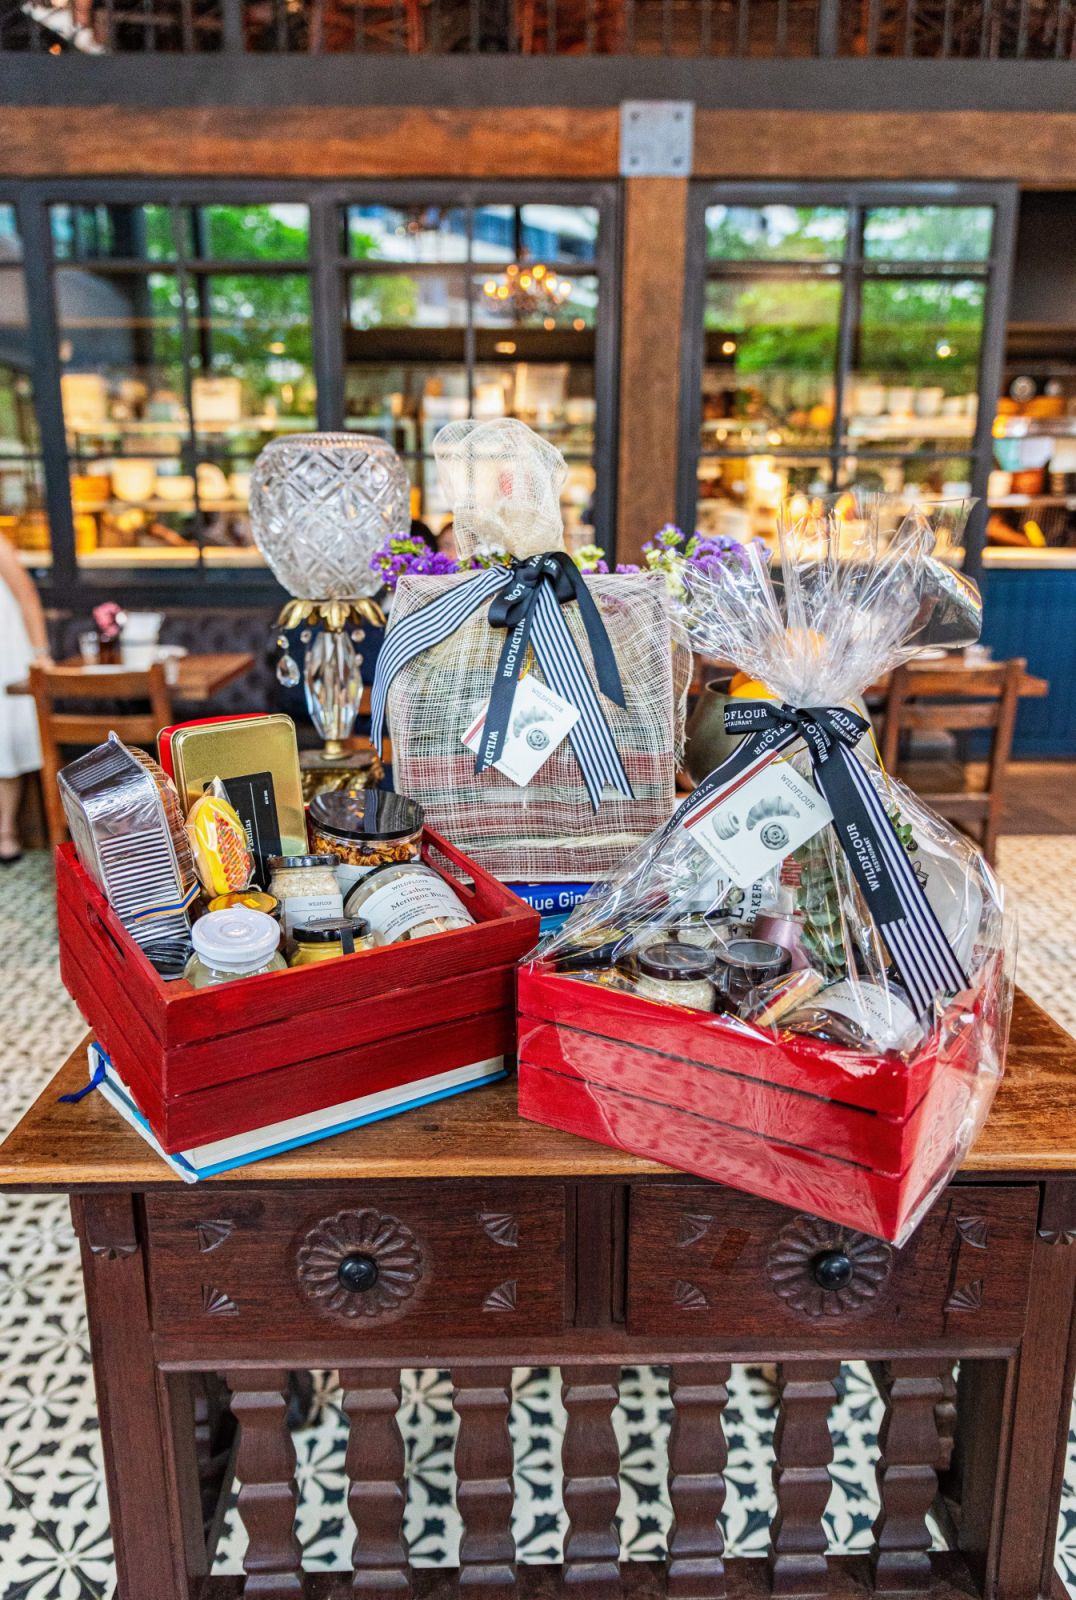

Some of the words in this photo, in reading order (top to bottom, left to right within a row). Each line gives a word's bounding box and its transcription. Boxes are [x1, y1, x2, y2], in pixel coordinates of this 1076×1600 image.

[781, 774, 816, 811] WILDFLOUR
[846, 823, 880, 892] WILDFLOUR
[863, 837, 882, 873] RESTAURANT
[400, 886, 431, 896] Cashew
